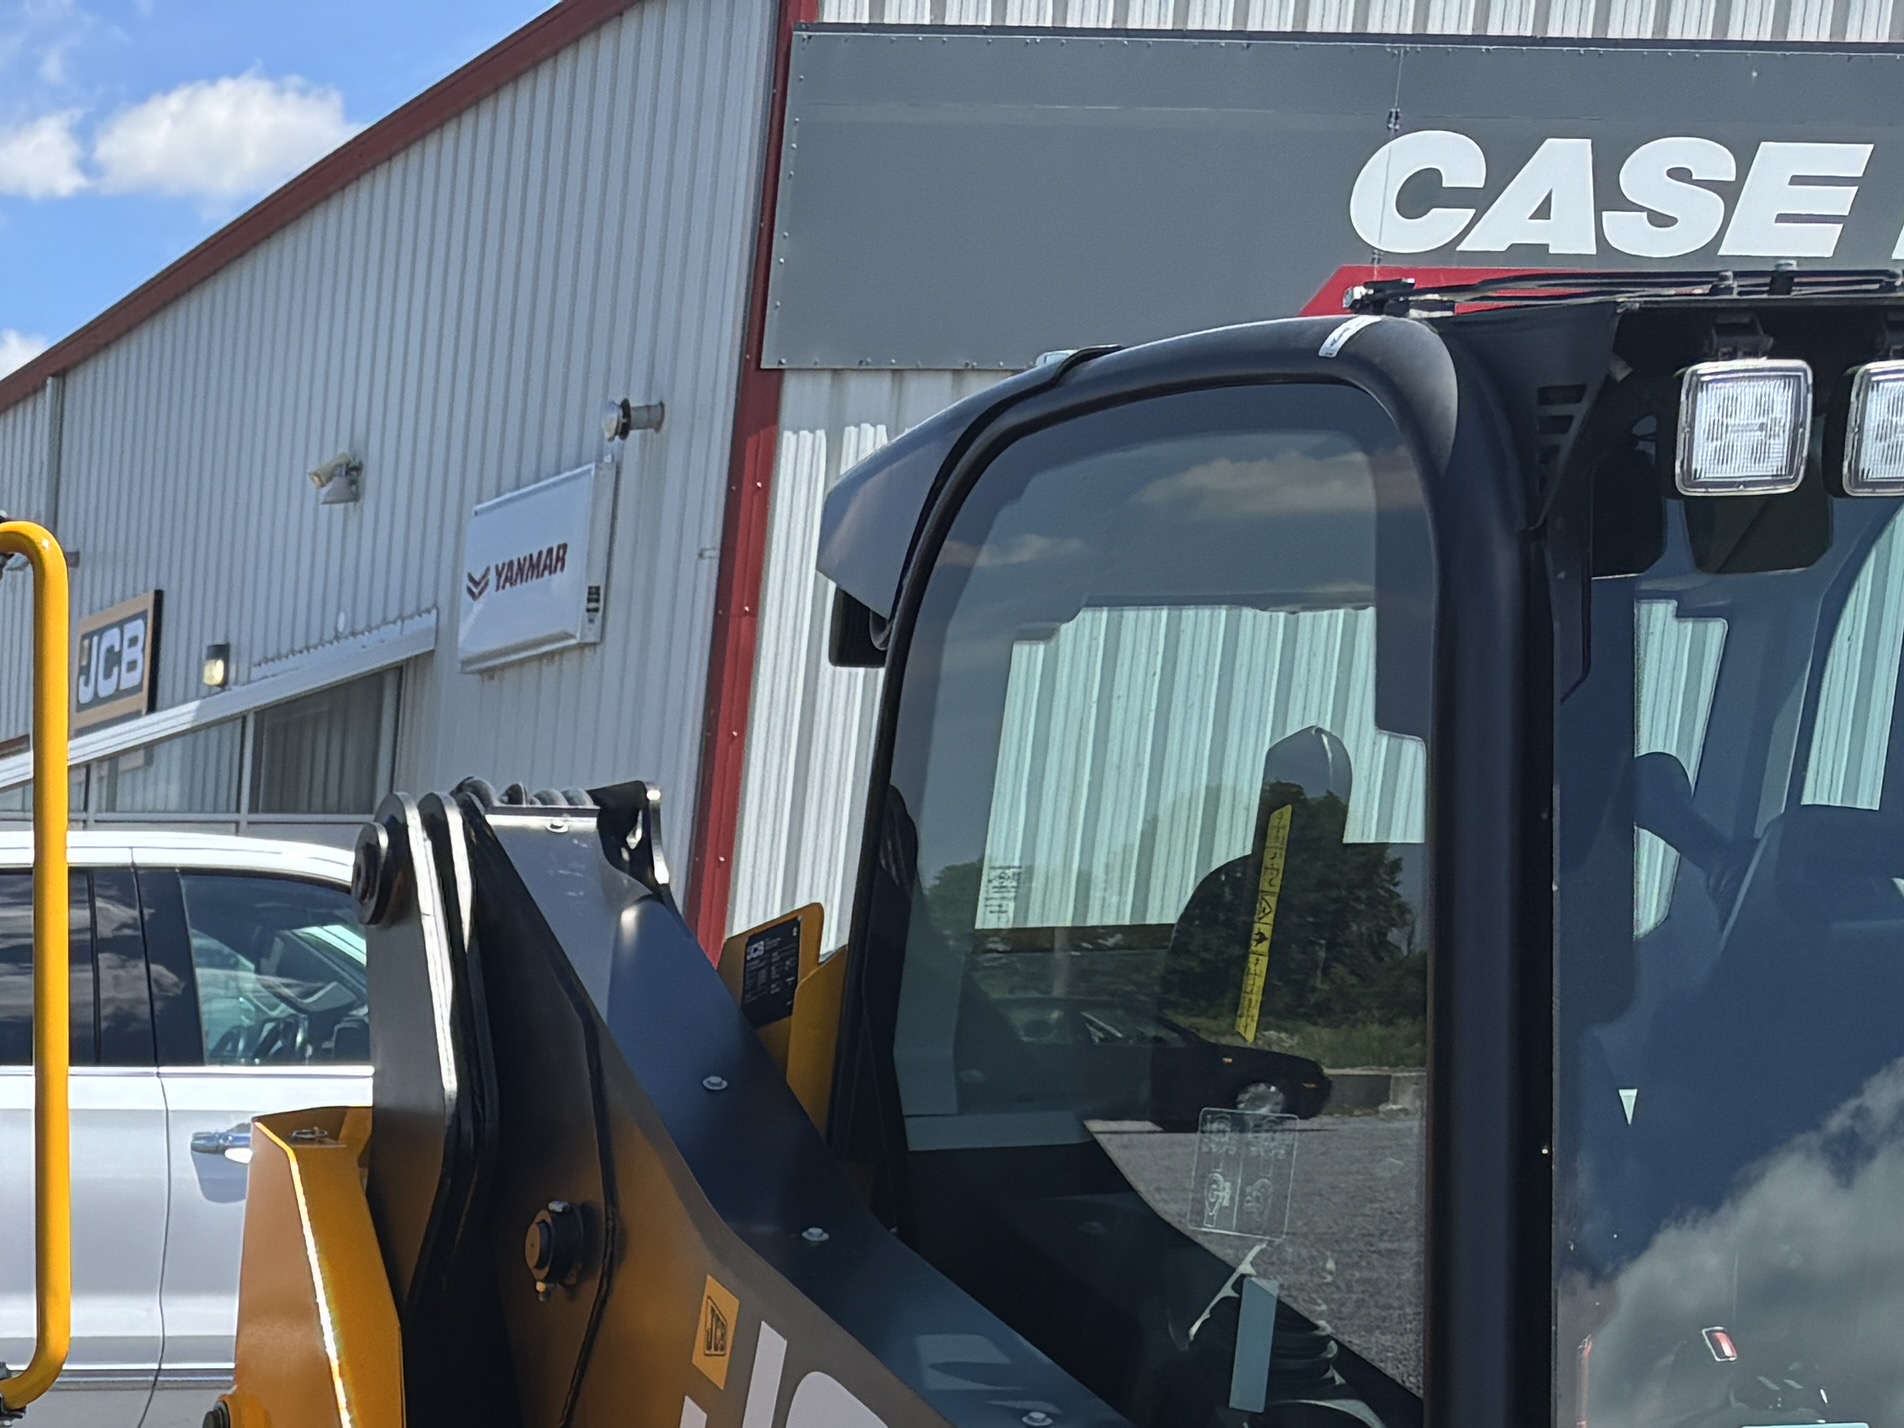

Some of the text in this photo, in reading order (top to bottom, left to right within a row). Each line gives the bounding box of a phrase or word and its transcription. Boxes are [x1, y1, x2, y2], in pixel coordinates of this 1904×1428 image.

[1349, 129, 1875, 258] CASE
[494, 542, 569, 593] YANMAR
[78, 618, 146, 705] JCB
